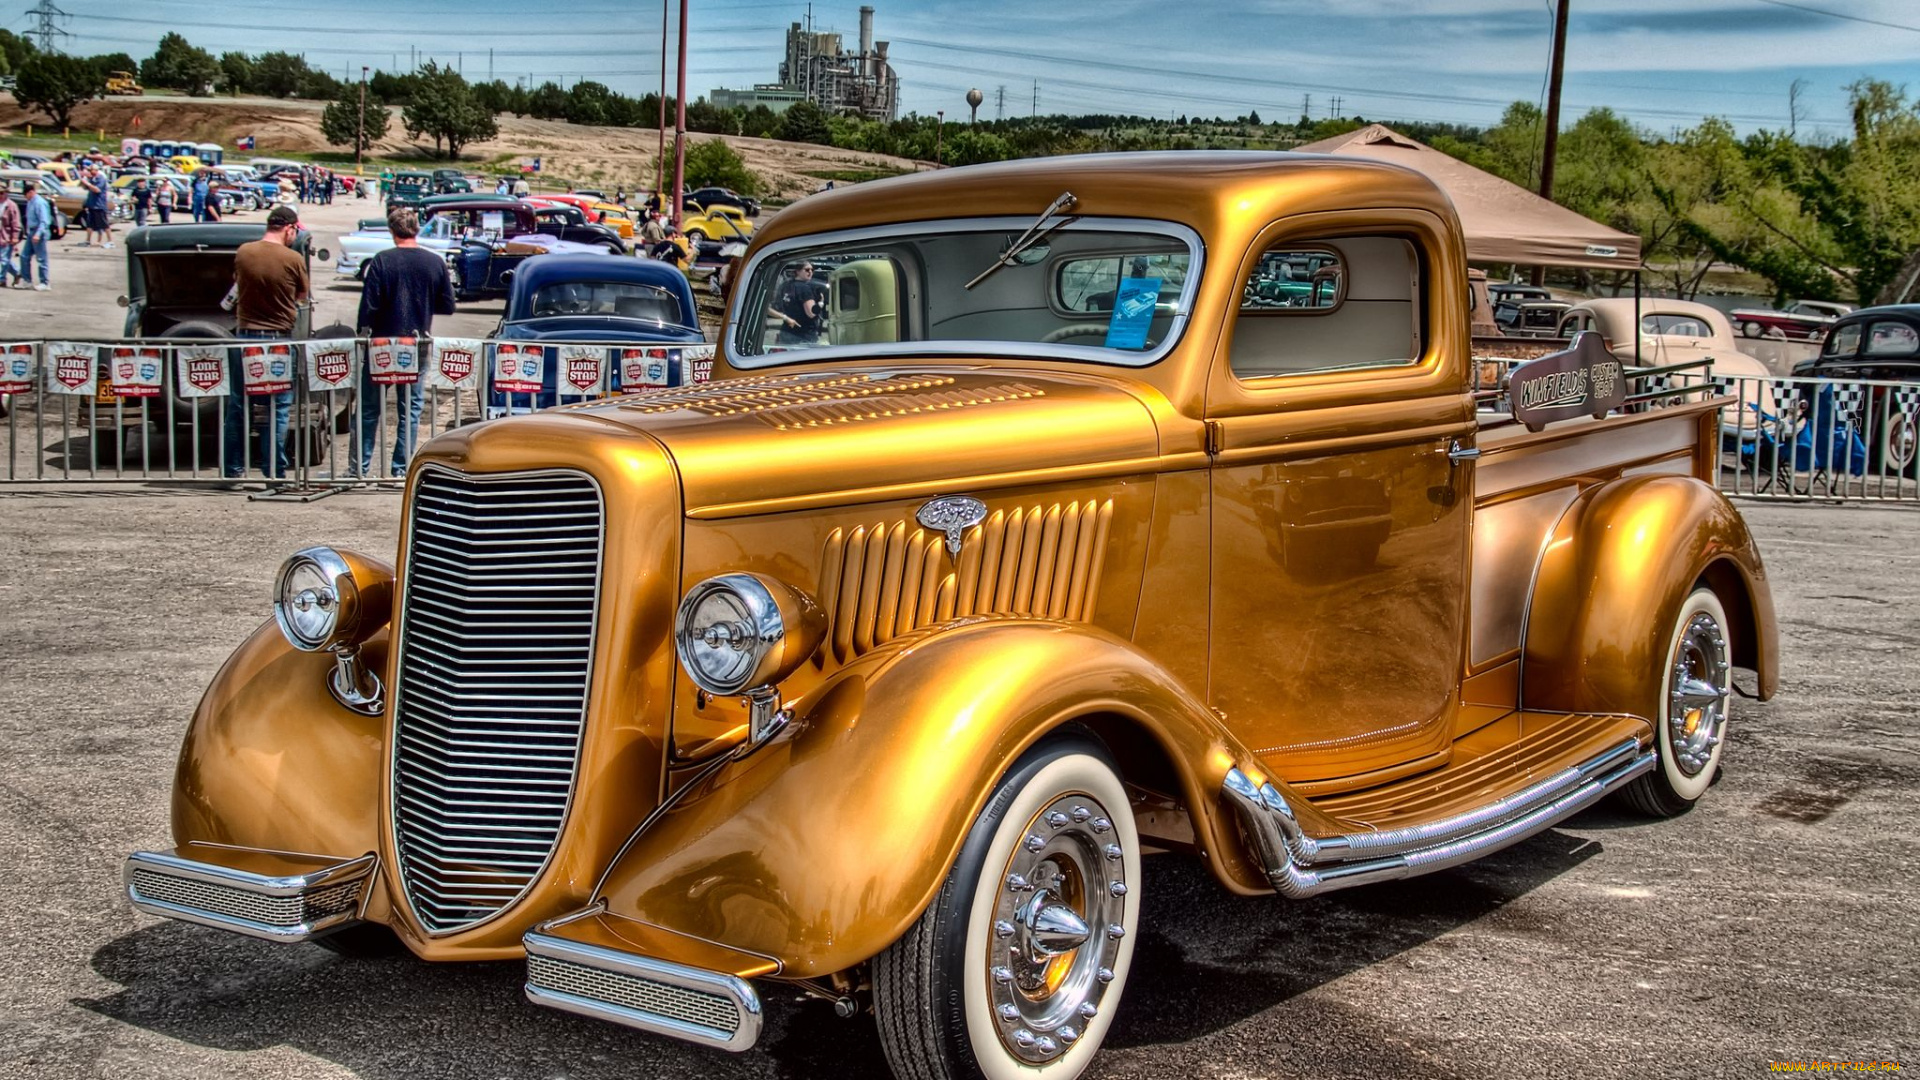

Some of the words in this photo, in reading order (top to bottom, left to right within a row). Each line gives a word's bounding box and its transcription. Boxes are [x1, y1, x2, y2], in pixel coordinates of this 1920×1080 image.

[319, 354, 345, 365] LONE
[443, 353, 471, 363] LONE
[59, 359, 87, 369] LONE
[191, 361, 218, 372] LONE
[319, 363, 347, 375] STAR
[441, 362, 470, 373] STAR
[570, 361, 597, 371] LONE
[694, 361, 714, 371] LON
[58, 369, 87, 380] STAR
[190, 371, 219, 382] STAR
[569, 371, 597, 381] STAR
[1591, 362, 1619, 382] CUSTOM
[1520, 368, 1588, 408] WINFIELD'S
[1594, 380, 1614, 399] SHOP
